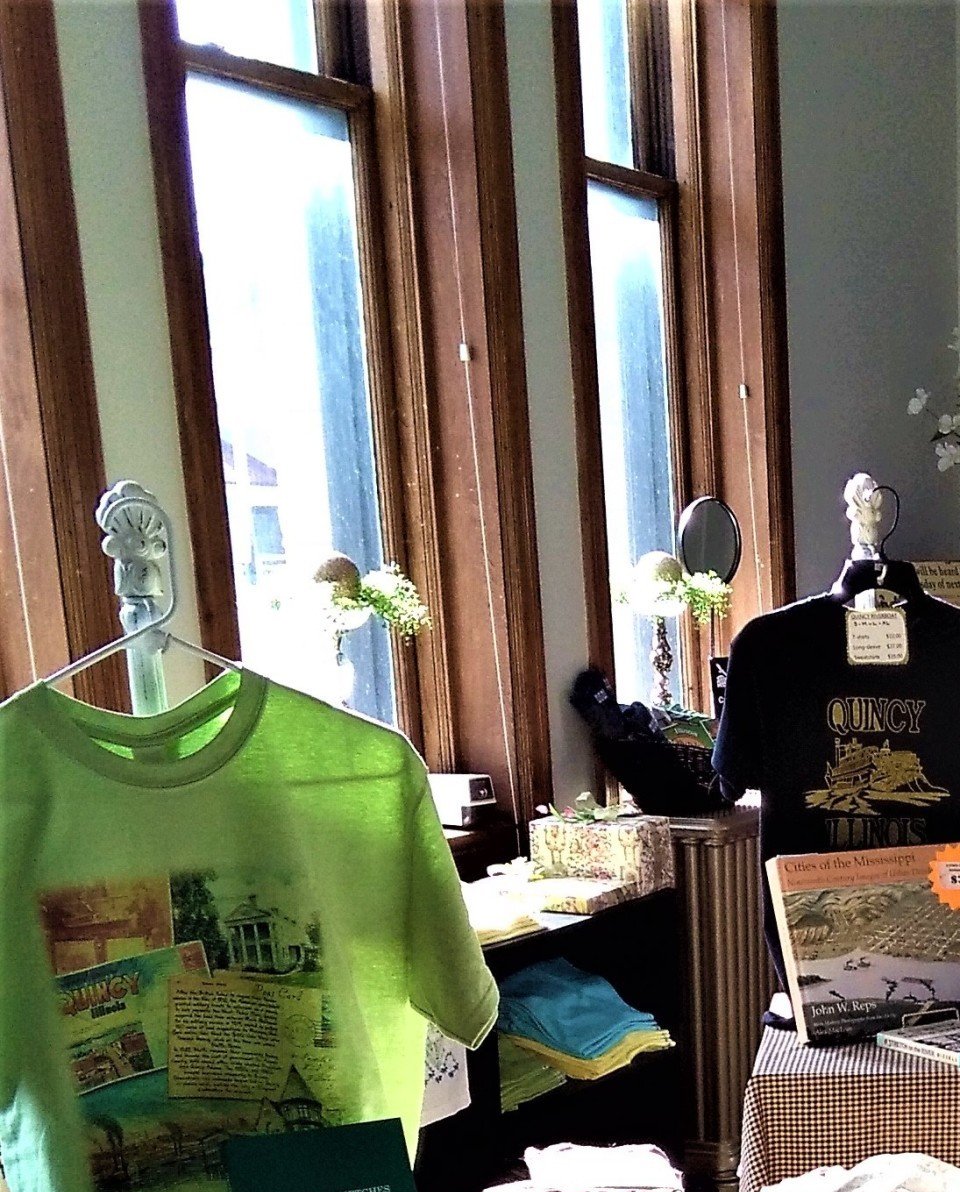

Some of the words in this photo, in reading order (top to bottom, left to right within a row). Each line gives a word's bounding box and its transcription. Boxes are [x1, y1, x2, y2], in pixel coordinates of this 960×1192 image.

[937, 578, 946, 589] of
[946, 580, 960, 589] next
[826, 696, 926, 735] QUINCY
[783, 860, 818, 873] Cities
[819, 857, 833, 870] of
[834, 857, 852, 869] the
[854, 852, 916, 868] Mississippi
[59, 971, 140, 1017] QUINCY
[811, 1004, 835, 1018] John
[836, 1002, 850, 1013] W.
[852, 1000, 877, 1013] Reps
